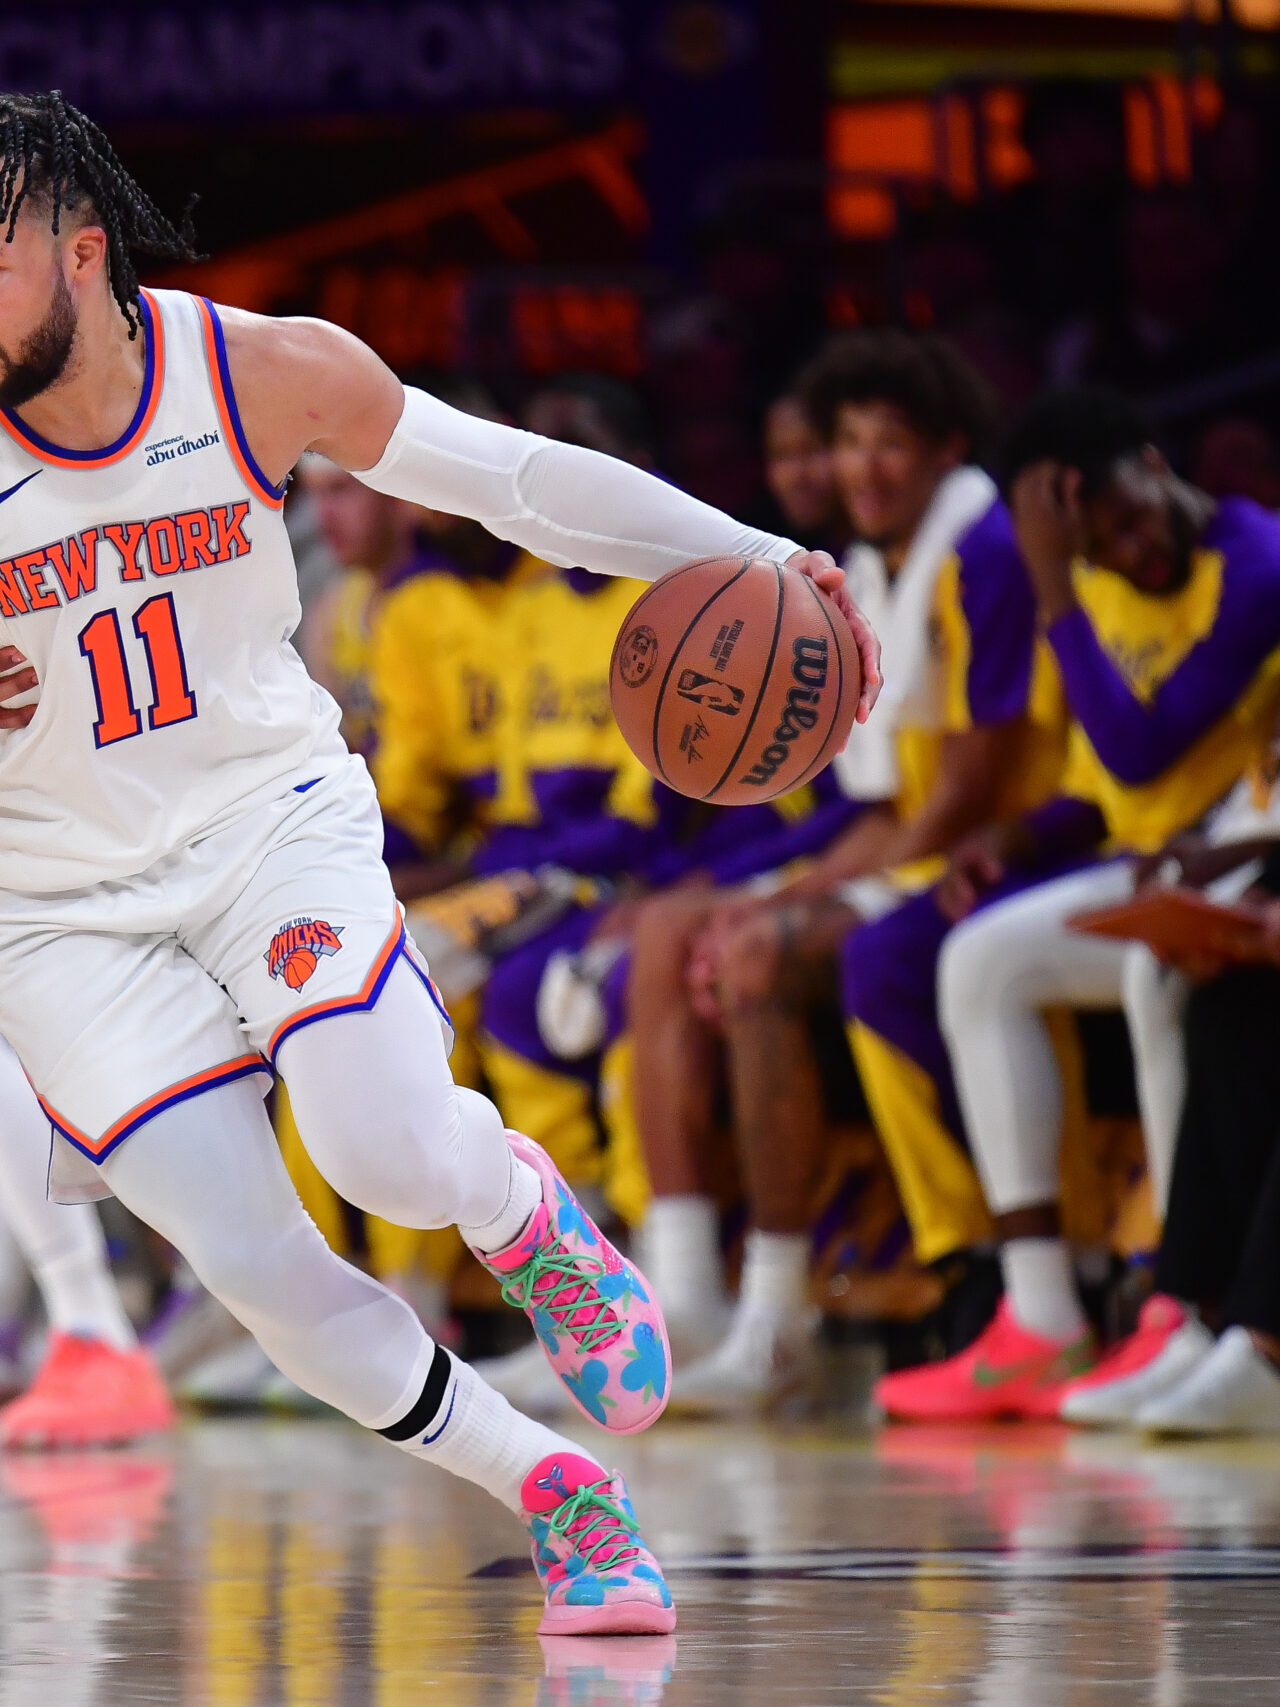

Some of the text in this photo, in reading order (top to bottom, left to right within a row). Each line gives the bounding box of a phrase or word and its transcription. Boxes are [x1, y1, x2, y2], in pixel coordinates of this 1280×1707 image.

[144, 434, 184, 452] experience
[146, 448, 175, 466] abu
[103, 498, 252, 584] YORK
[77, 591, 198, 750] 11
[739, 635, 829, 786] Wilson
[268, 919, 343, 978] KNICKS
